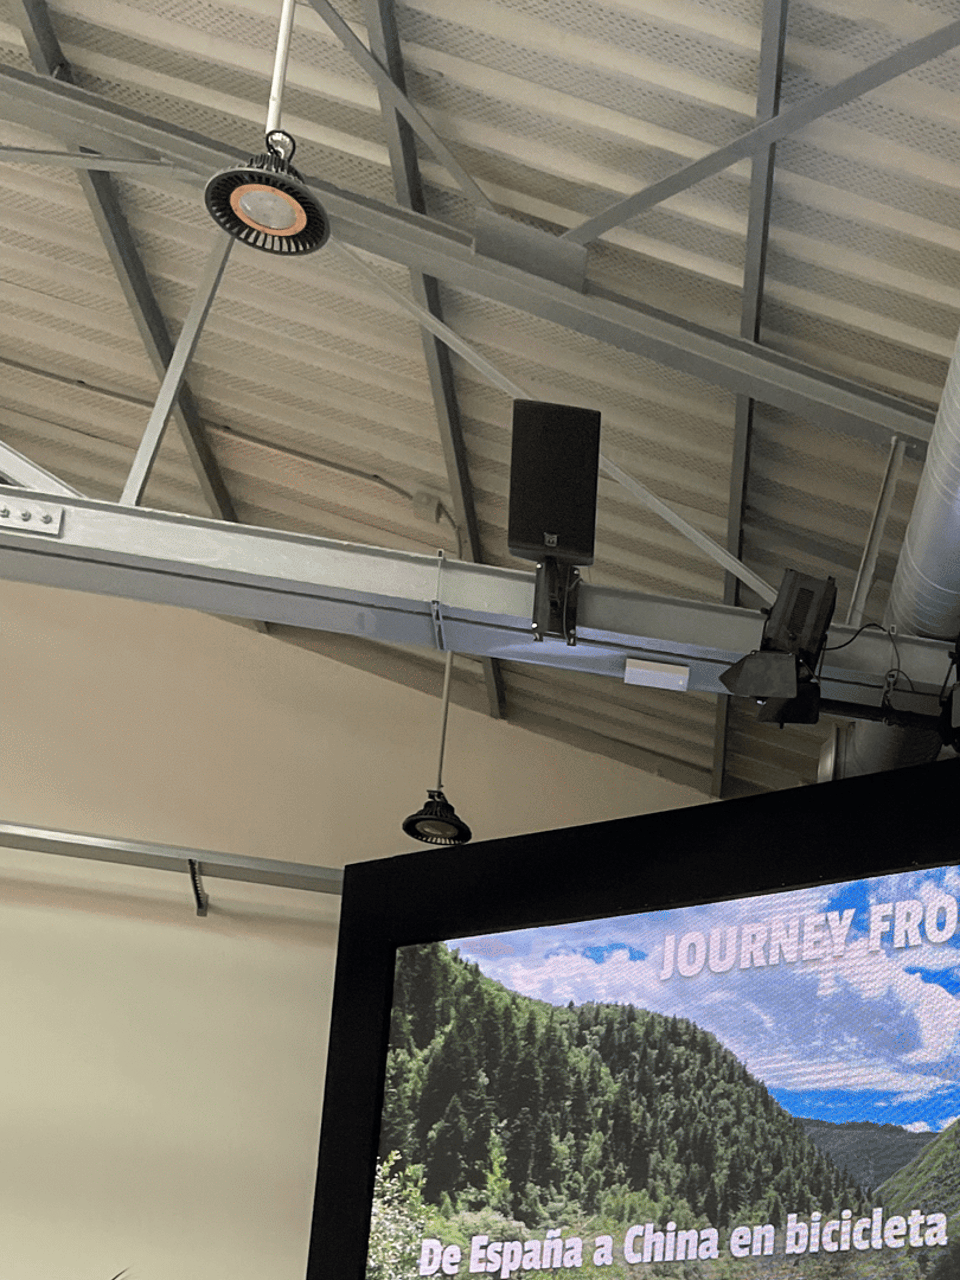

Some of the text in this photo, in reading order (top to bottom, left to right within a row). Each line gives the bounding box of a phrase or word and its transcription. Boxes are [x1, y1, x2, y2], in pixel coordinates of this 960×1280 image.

[660, 907, 856, 982] JOURNEY
[419, 1208, 948, 1279] De España a China en bicicleta
